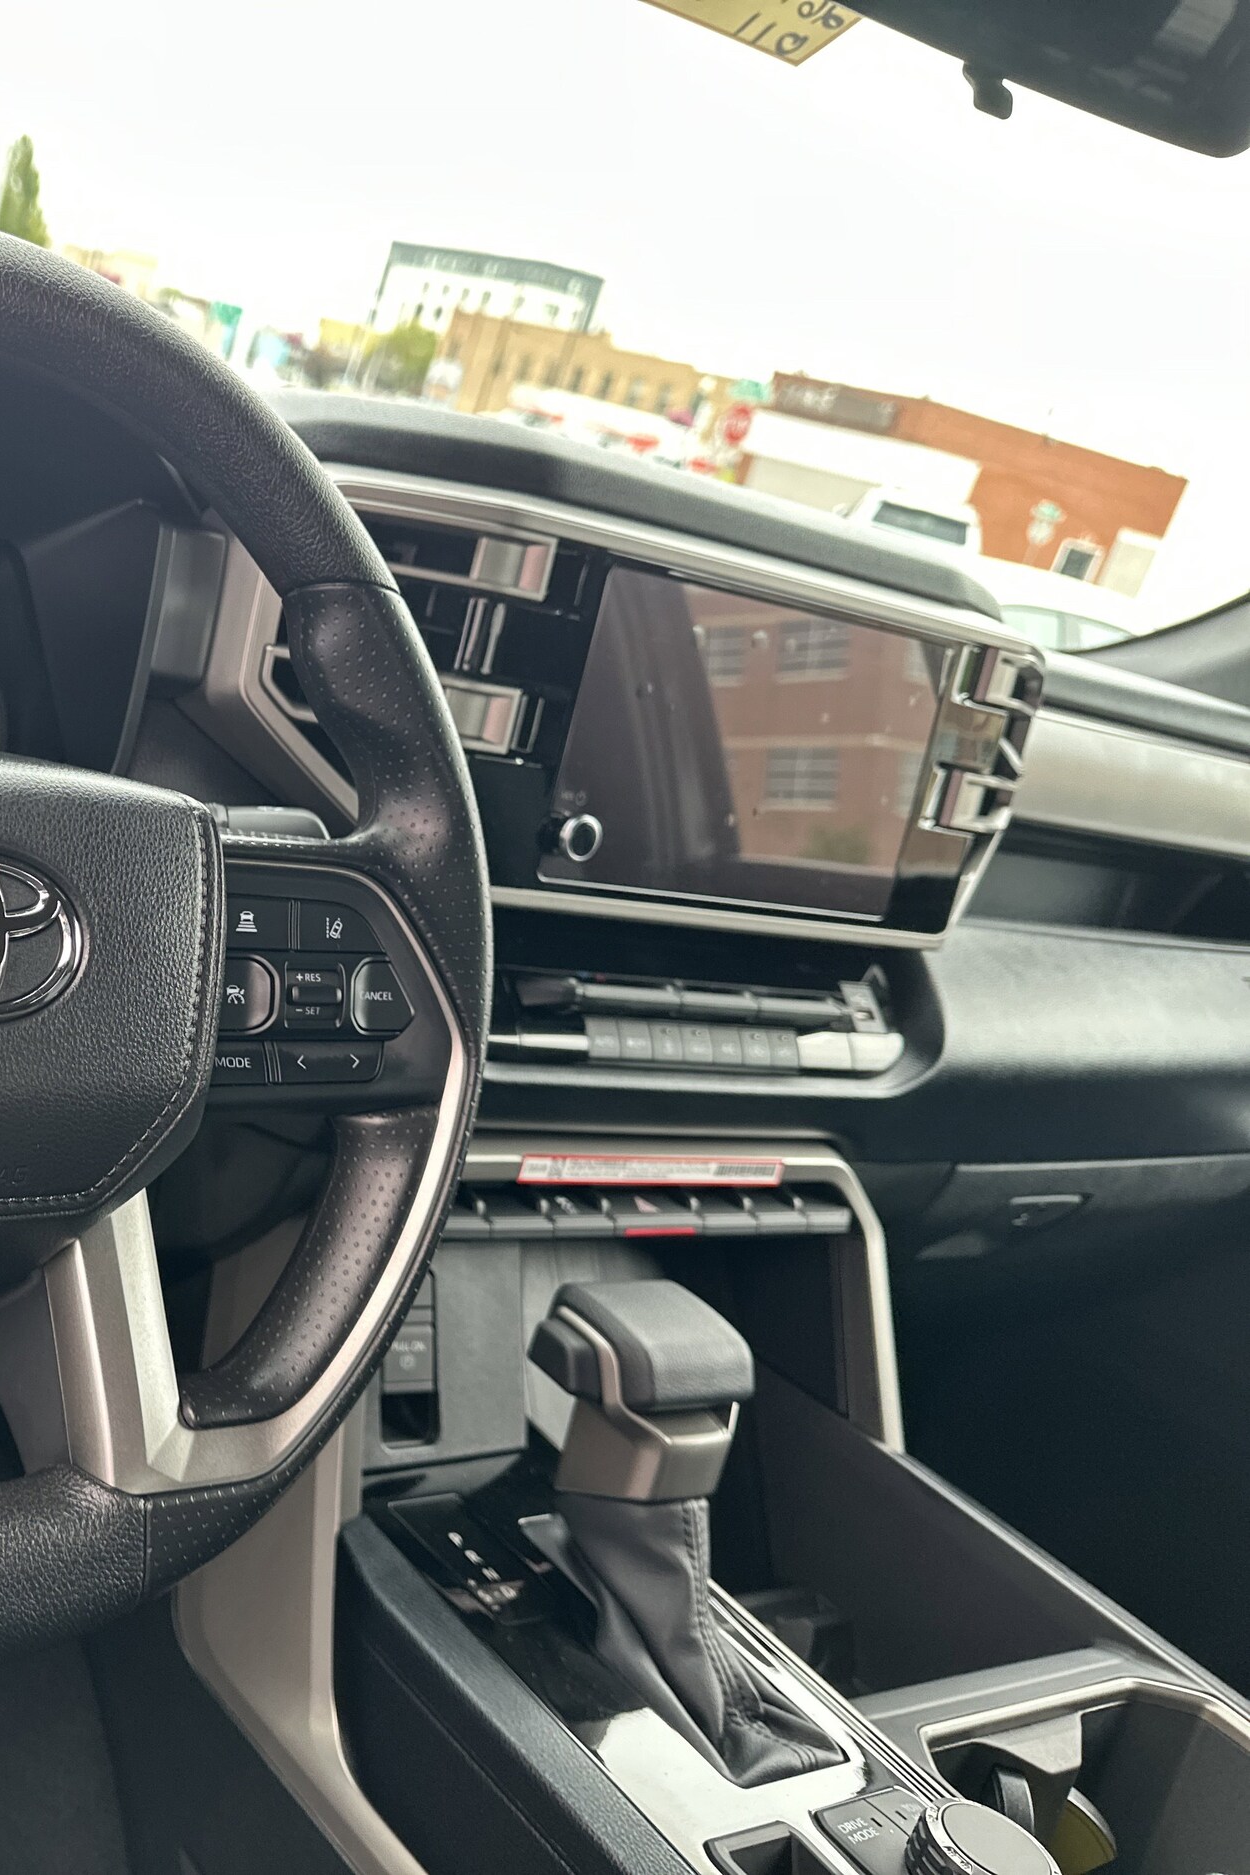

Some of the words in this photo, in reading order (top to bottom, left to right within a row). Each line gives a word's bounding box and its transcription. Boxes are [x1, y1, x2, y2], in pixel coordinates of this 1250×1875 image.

[359, 991, 394, 1001] CANCEL
[214, 1058, 252, 1068] MODE
[837, 1817, 869, 1834] DRIVE
[847, 1826, 881, 1845] MODE
